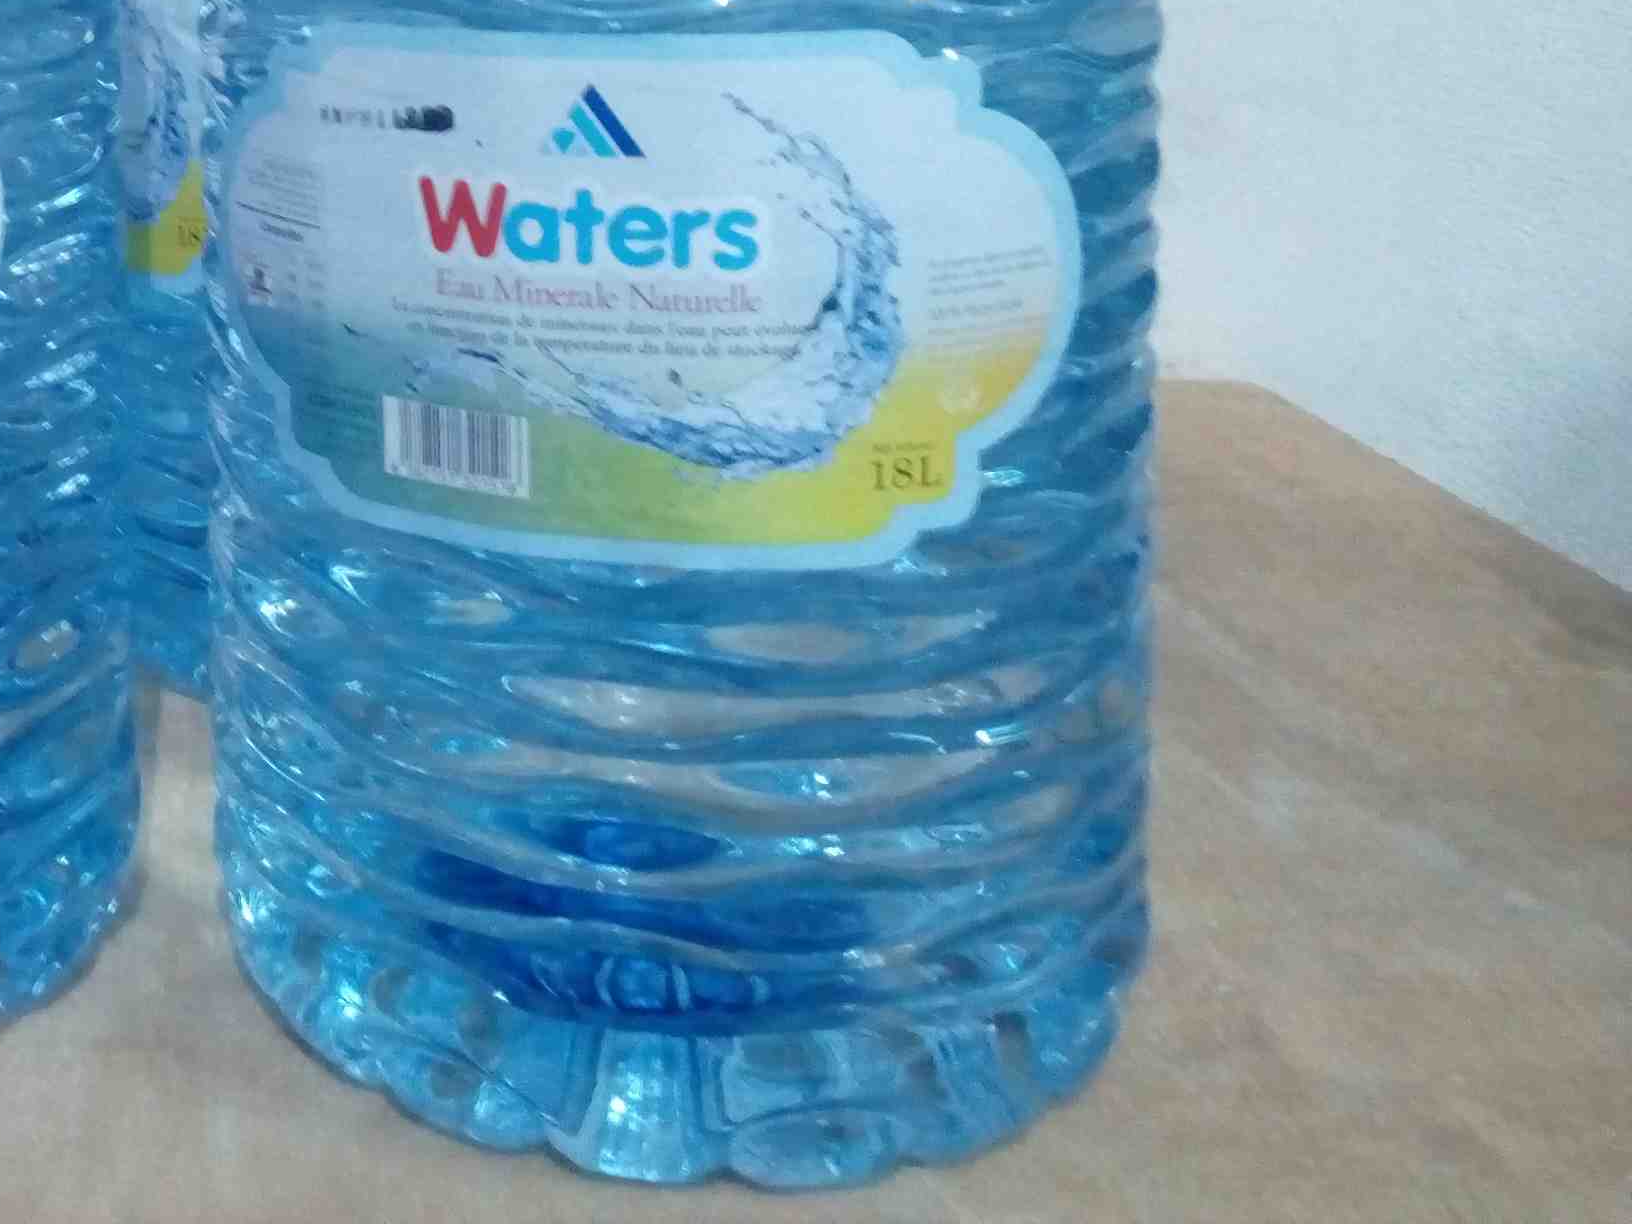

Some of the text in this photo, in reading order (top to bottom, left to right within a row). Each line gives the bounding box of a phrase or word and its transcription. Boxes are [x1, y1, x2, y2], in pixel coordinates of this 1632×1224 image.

[419, 176, 759, 271] Waters
[435, 269, 485, 298] Eau
[627, 282, 763, 314] Naturelle
[869, 456, 944, 491] 18L
